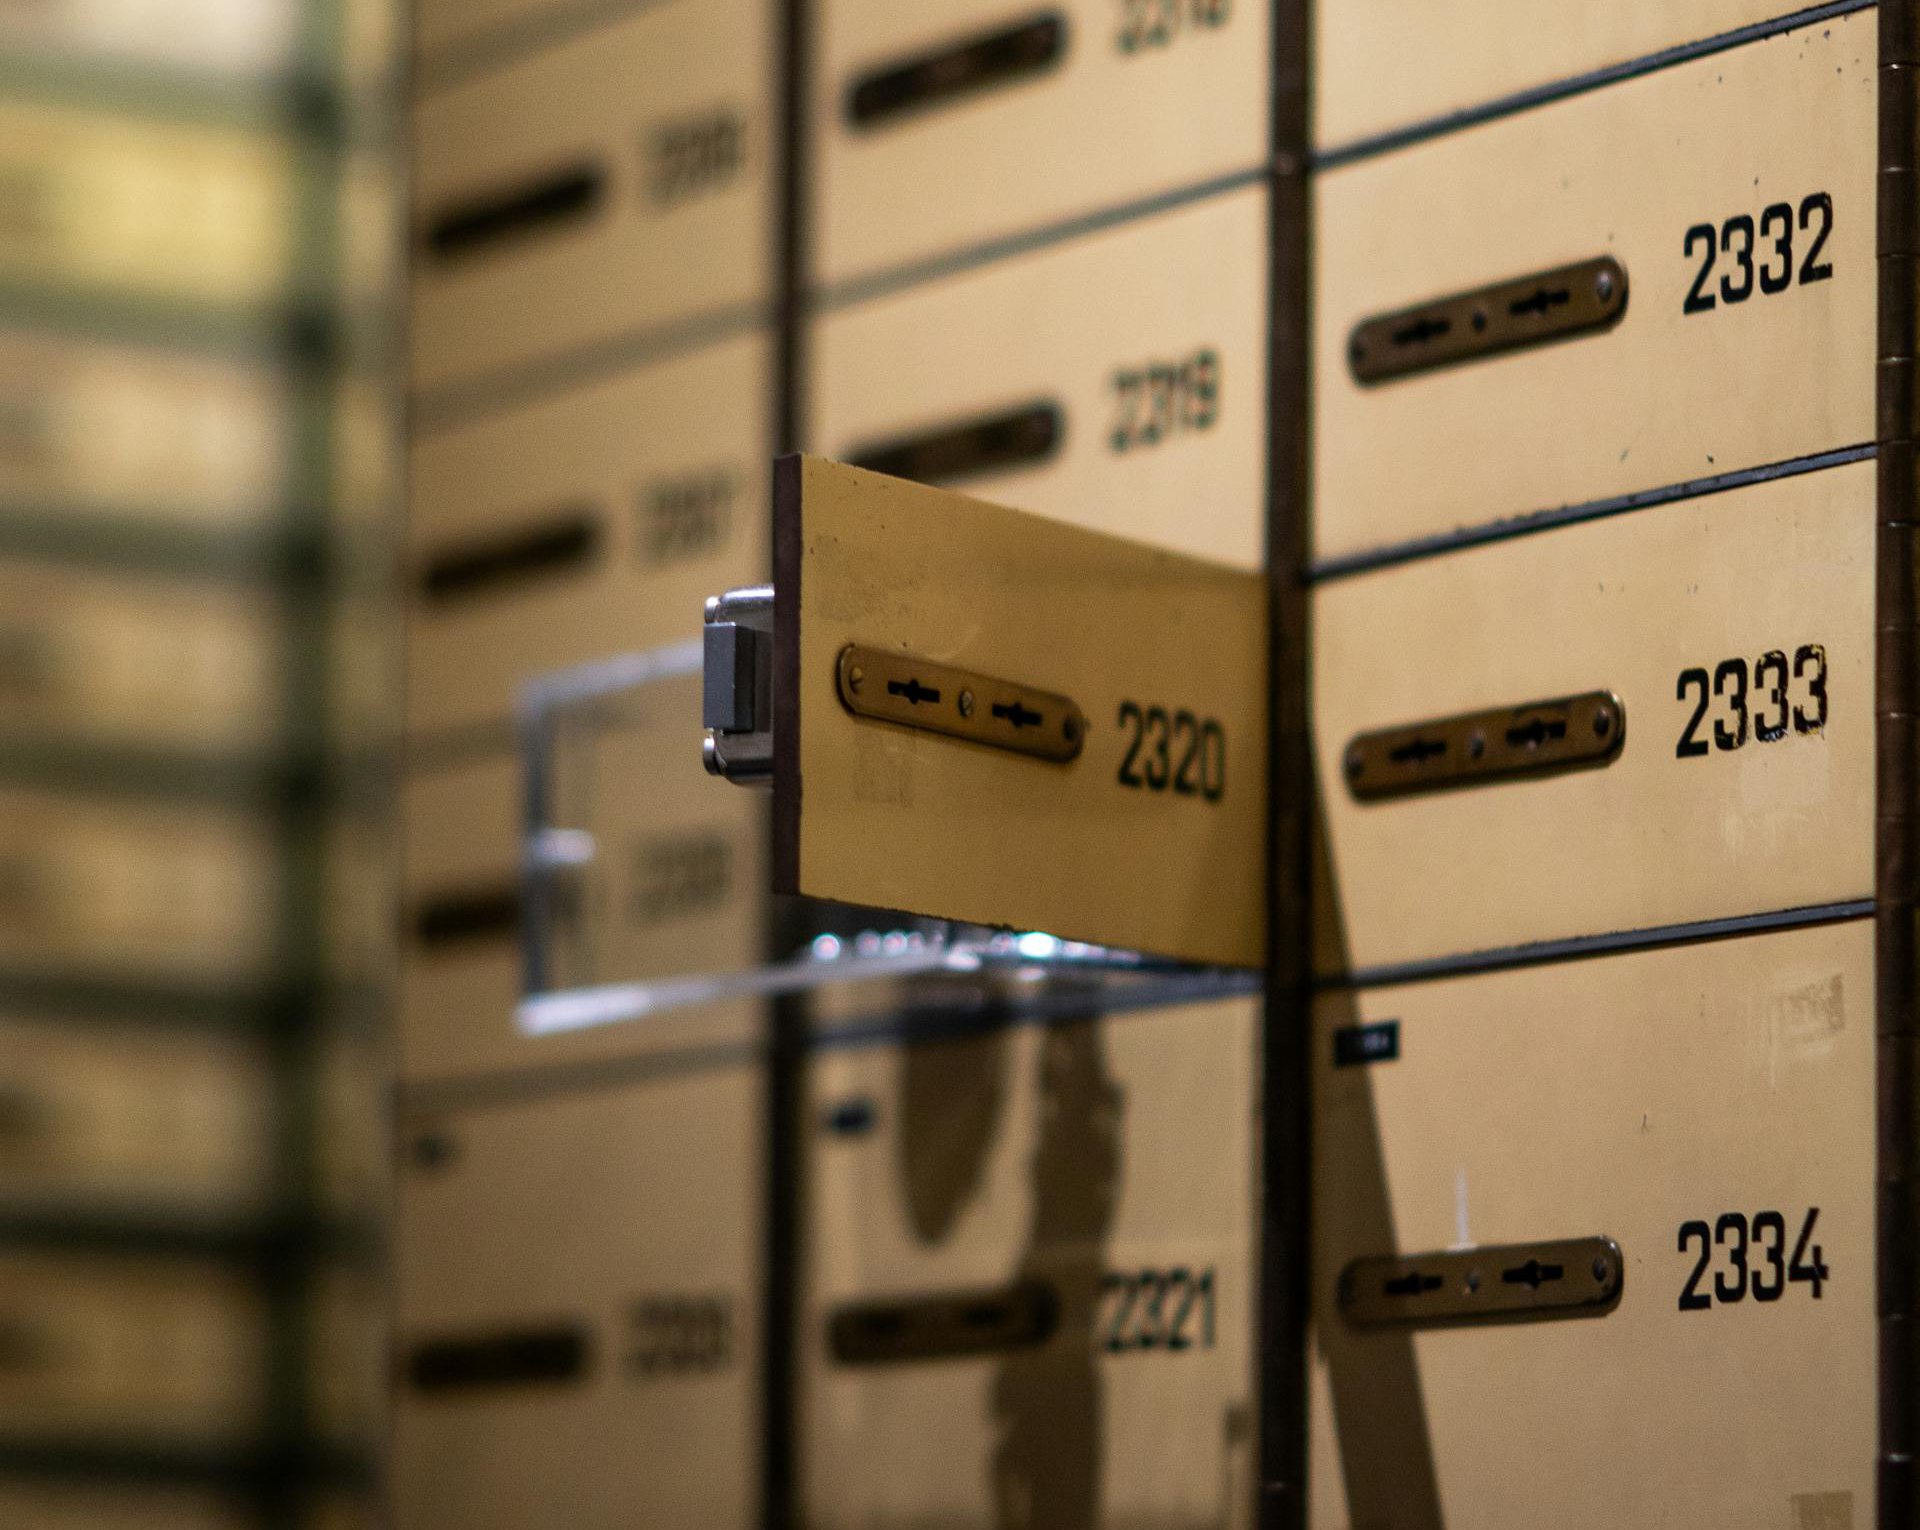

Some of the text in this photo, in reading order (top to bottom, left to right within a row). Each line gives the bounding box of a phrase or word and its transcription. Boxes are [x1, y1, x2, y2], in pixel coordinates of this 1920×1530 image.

[1683, 190, 1833, 315] 2332
[1118, 701, 1224, 804] 2320
[1676, 643, 1828, 759] 2333
[1098, 1267, 1216, 1351] 2321
[1678, 1207, 1829, 1311] 2334
